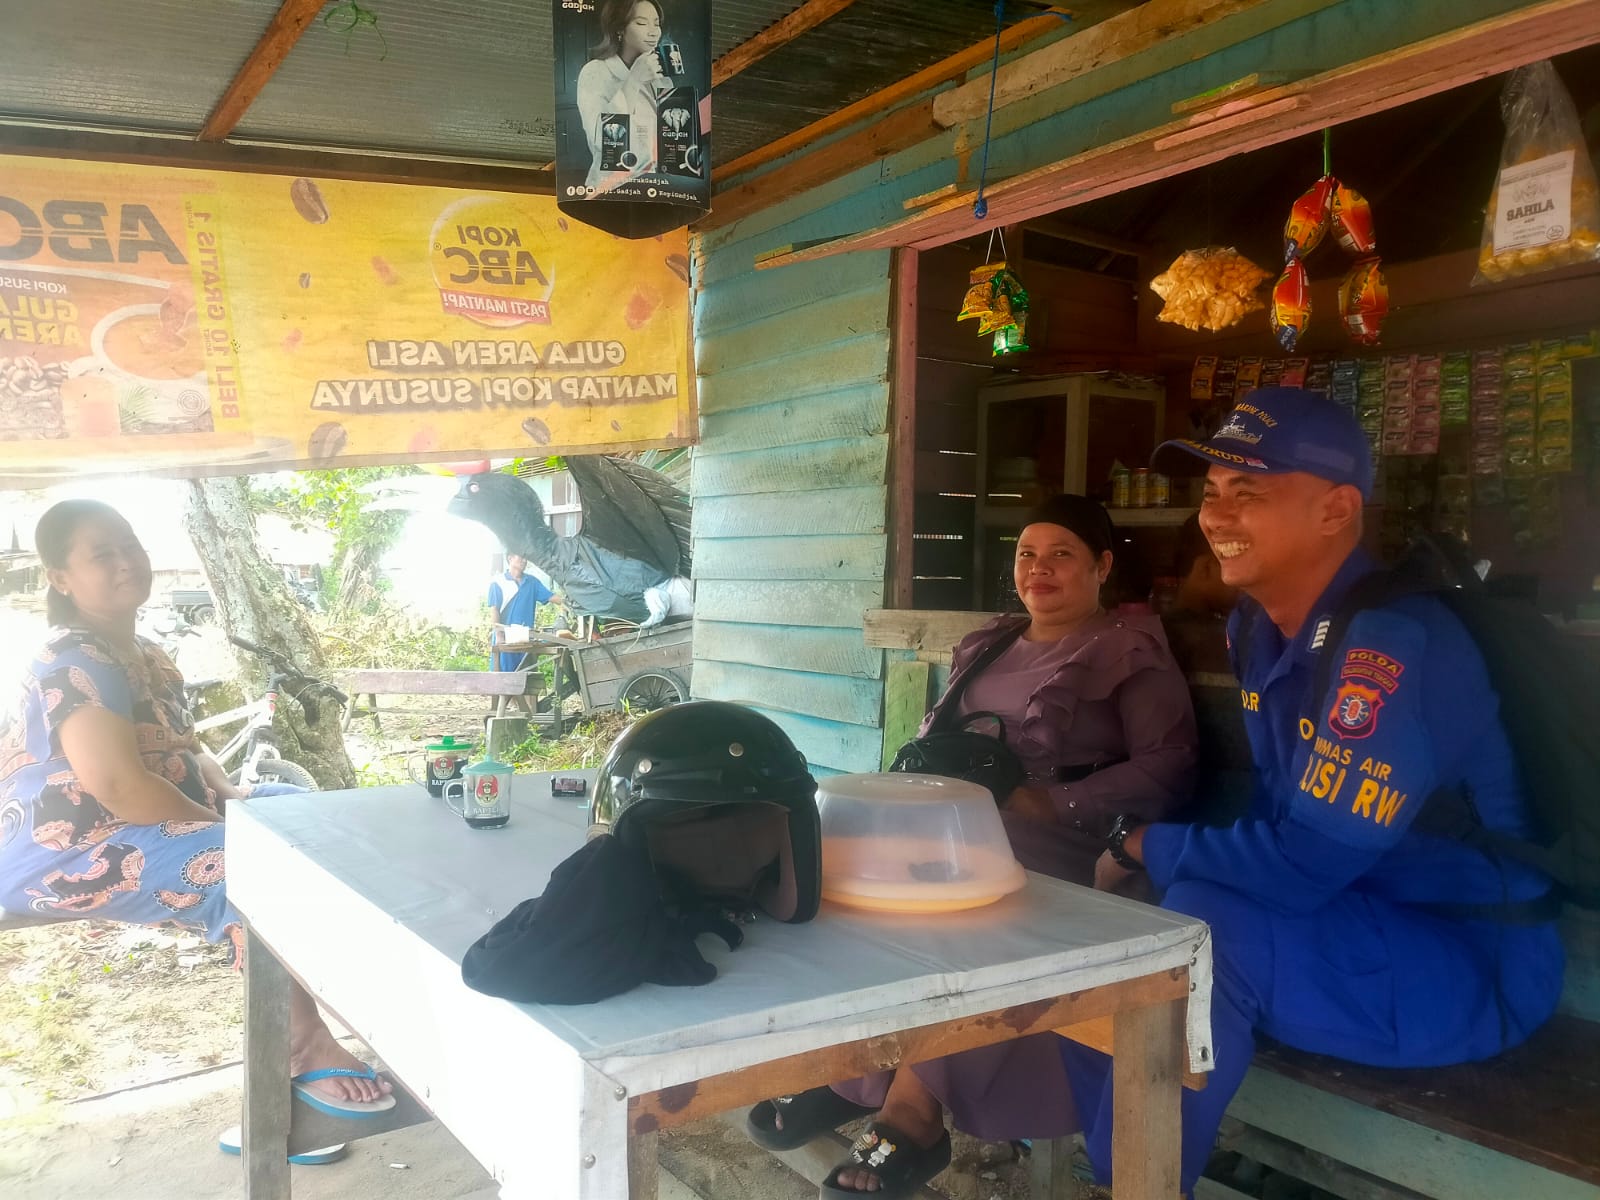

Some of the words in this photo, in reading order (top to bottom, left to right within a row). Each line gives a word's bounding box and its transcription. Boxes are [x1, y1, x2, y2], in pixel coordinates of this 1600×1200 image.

[1349, 651, 1398, 675] POLDA
[1359, 756, 1392, 781] AIR
[1352, 777, 1408, 828] RW
